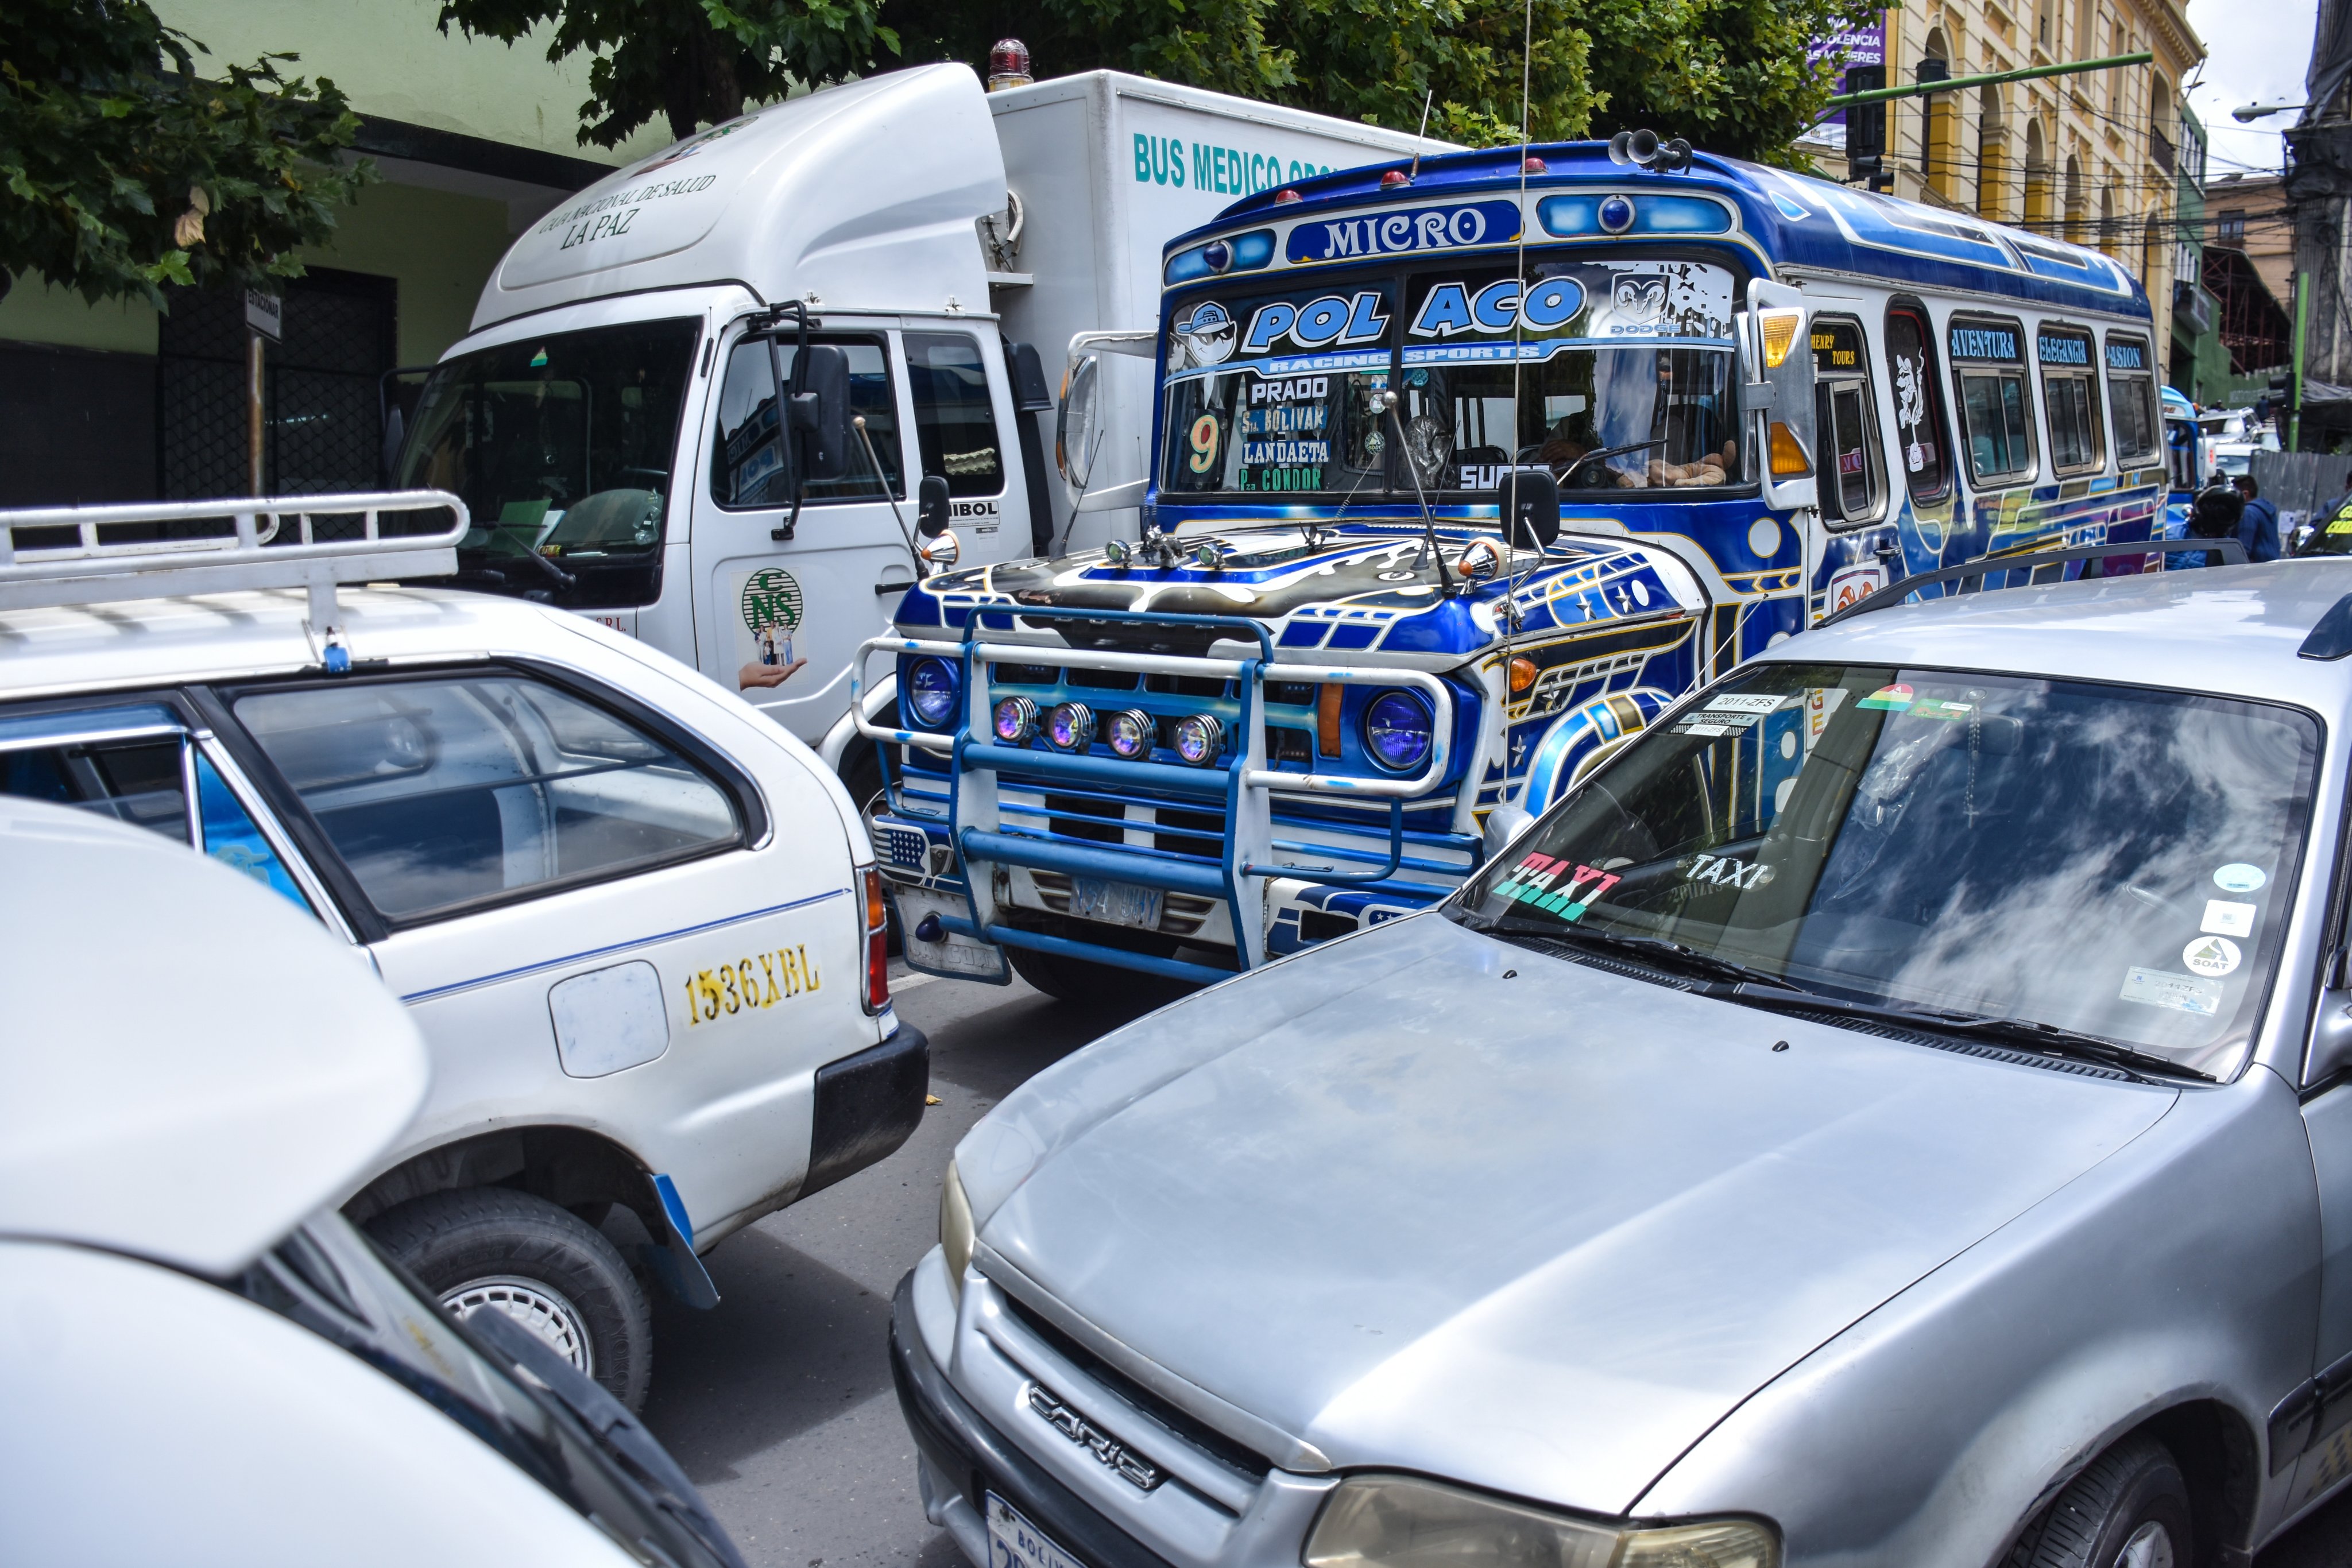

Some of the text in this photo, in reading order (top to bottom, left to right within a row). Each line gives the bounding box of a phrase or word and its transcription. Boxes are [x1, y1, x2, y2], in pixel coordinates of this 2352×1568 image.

[1814, 33, 1881, 47] VOLENCIA
[1824, 49, 1881, 64] MJERES
[1134, 133, 1185, 188] BUS
[1193, 142, 1282, 196] MEDICO
[539, 175, 717, 234] CAJA NACIONAL DE SALUD
[560, 208, 641, 250] LA PAZ
[1324, 208, 1486, 258] MICRO
[248, 290, 279, 320] ESTACIONAR
[1240, 276, 1588, 354] POL ACO
[1610, 323, 1681, 335] DODGE
[1811, 334, 1835, 349] HENRY
[1832, 350, 1855, 365] TOURS
[1951, 328, 2016, 359] AVENTURA
[2038, 336, 2087, 364] ELEGANCIA
[1269, 345, 1540, 373] RACING SPORTS
[1251, 377, 1328, 405] PRADO
[1264, 405, 1324, 432] BOLIVAR
[1190, 415, 1219, 474] 9
[1244, 442, 1329, 464] LANDAETA
[1262, 468, 1321, 491] CONDOR
[758, 573, 783, 592] C
[1717, 697, 1775, 707] 2011-ZFS
[1686, 854, 1769, 889] TAXI
[1492, 851, 1622, 922] TAXI
[2192, 958, 2229, 970] SOAT
[685, 943, 820, 1027] 1536XBL
[1028, 1385, 1155, 1489] CARIB
